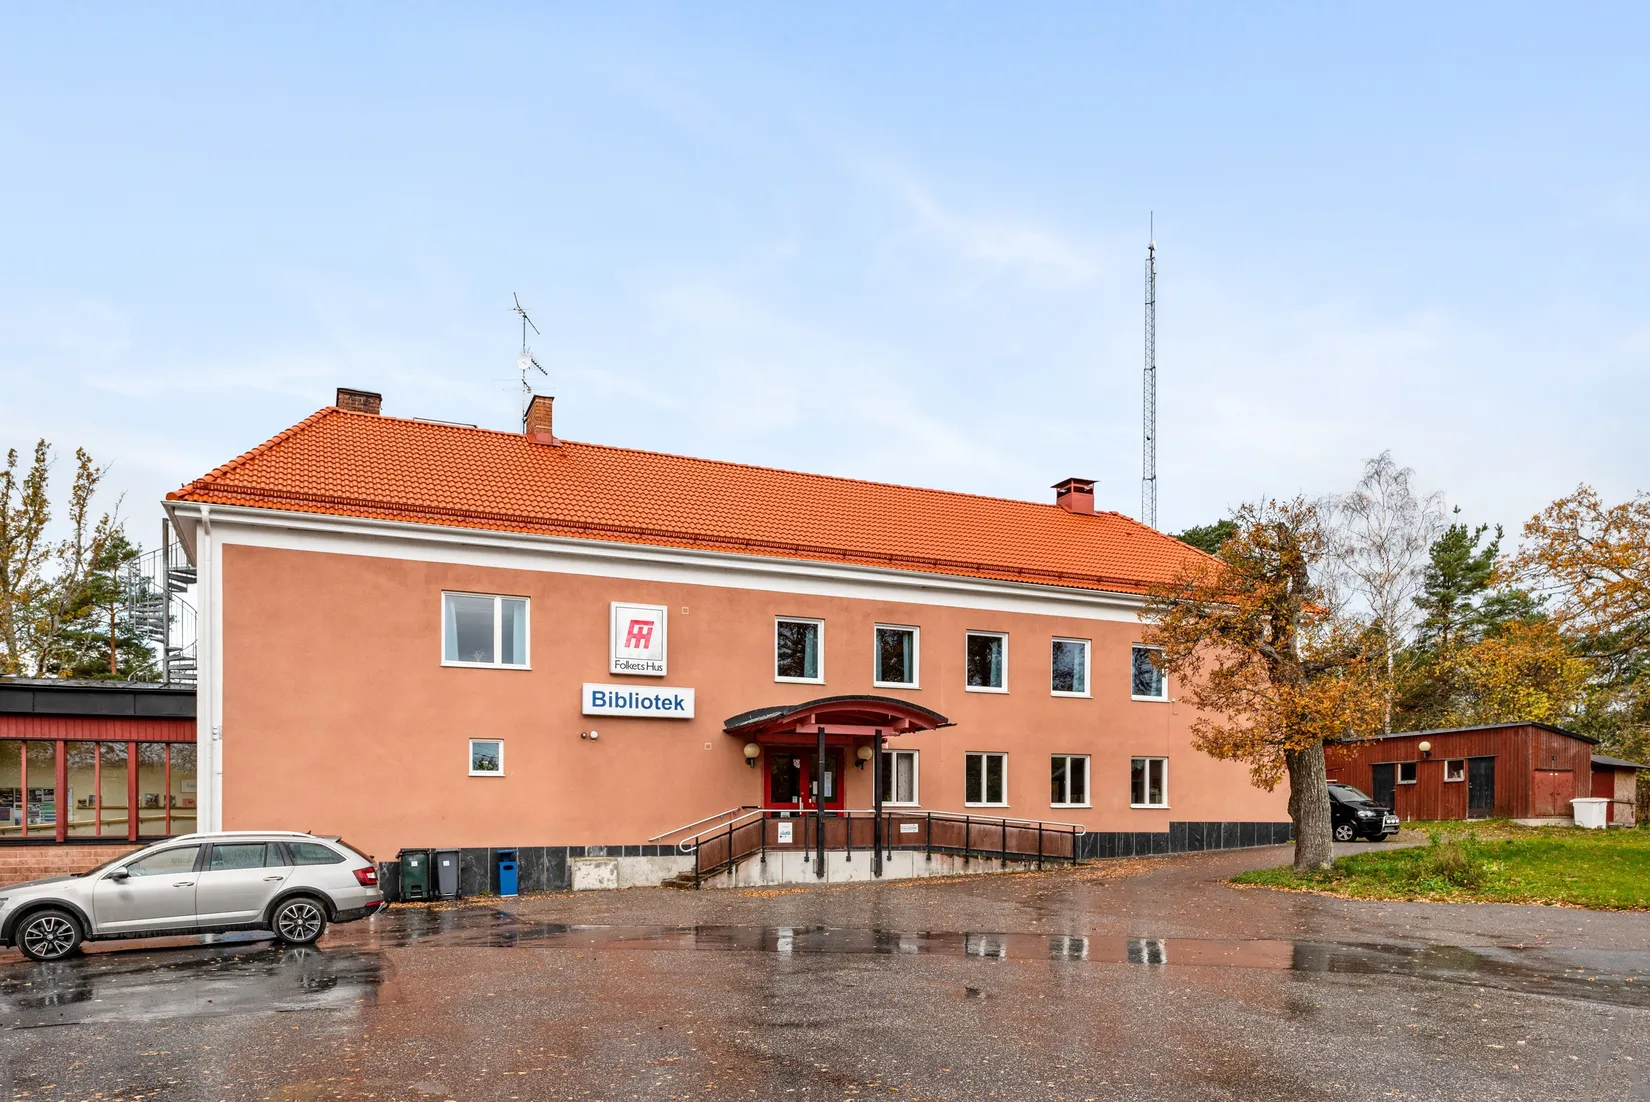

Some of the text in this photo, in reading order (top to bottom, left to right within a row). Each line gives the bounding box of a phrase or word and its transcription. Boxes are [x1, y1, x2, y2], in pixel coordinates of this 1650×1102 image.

[614, 660, 663, 672] Folkets Hus
[591, 690, 685, 711] Bibliotek
